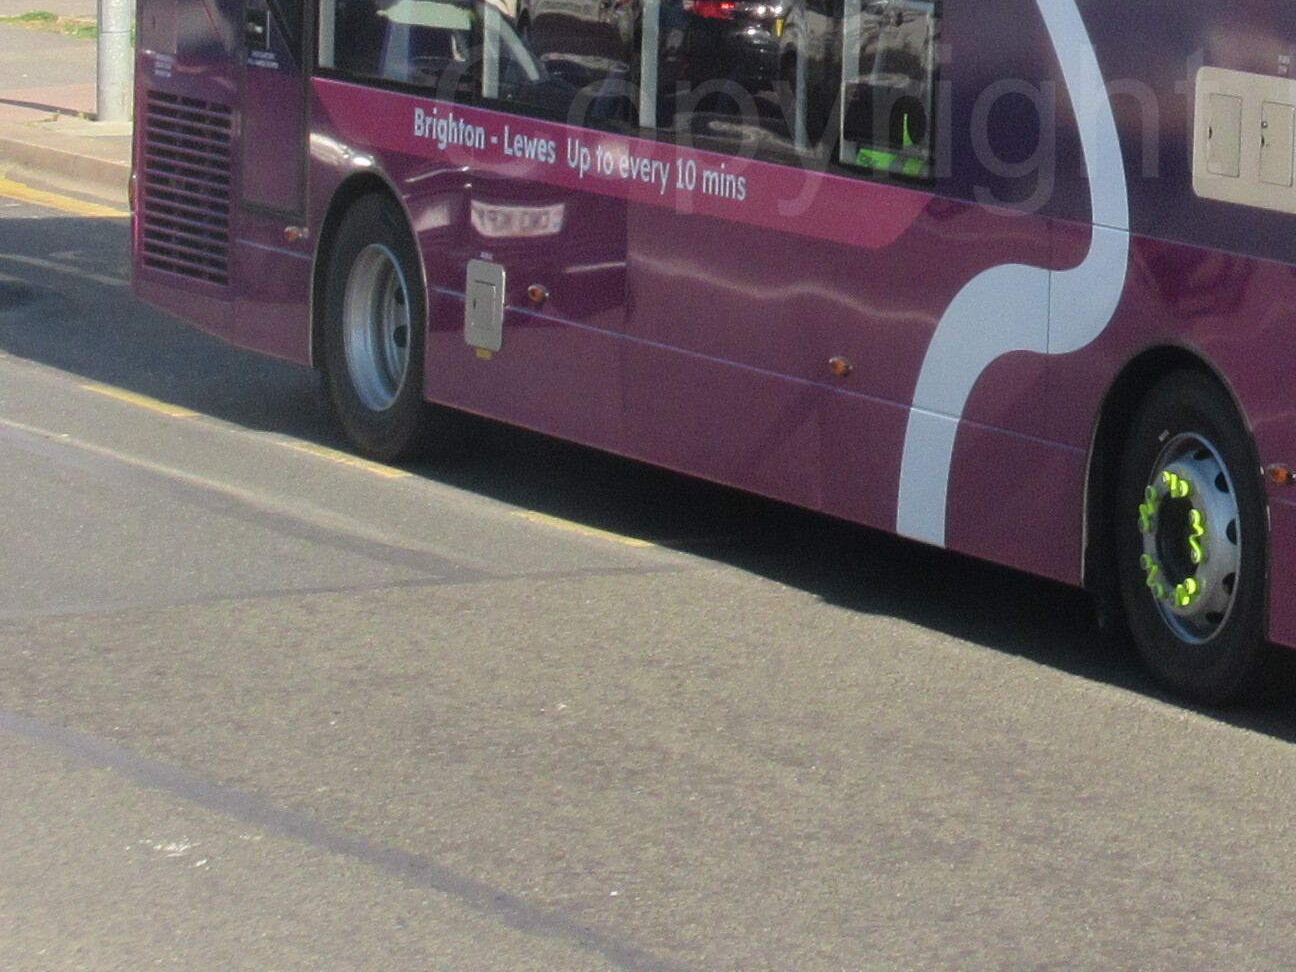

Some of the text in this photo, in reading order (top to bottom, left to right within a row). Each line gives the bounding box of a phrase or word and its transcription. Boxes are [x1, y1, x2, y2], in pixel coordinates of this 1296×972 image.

[413, 106, 486, 150] Brighton
[503, 124, 557, 164] Lewes
[566, 136, 591, 178] Up
[596, 145, 614, 175] to
[619, 154, 671, 195] every
[676, 157, 697, 191] 10
[702, 163, 747, 201] mins
